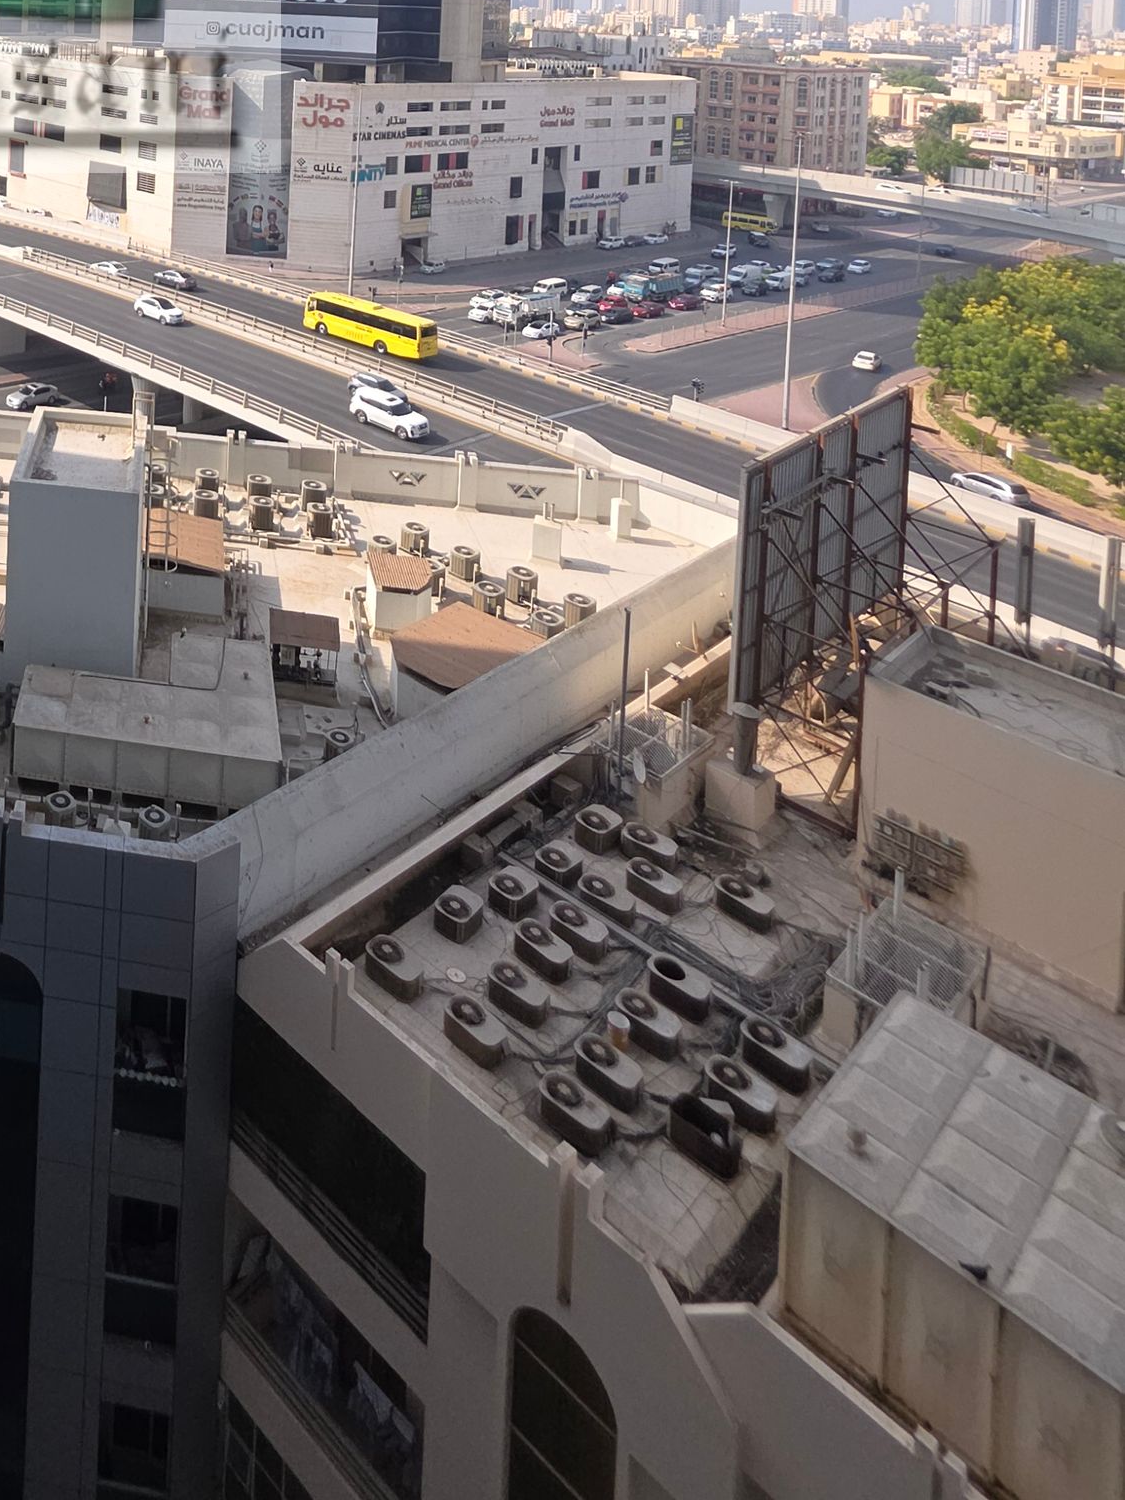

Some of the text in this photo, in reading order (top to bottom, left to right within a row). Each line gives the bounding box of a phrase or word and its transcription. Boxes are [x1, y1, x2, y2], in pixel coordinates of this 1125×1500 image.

[225, 20, 325, 42] cuajman
[179, 85, 231, 102] Grand
[186, 103, 221, 119] Mall
[297, 93, 351, 113] جراند
[302, 110, 345, 128] مول
[374, 130, 407, 141] CINEMAS
[405, 138, 470, 149] PRIME MEDICAL CENTER
[193, 157, 224, 169] INAYA
